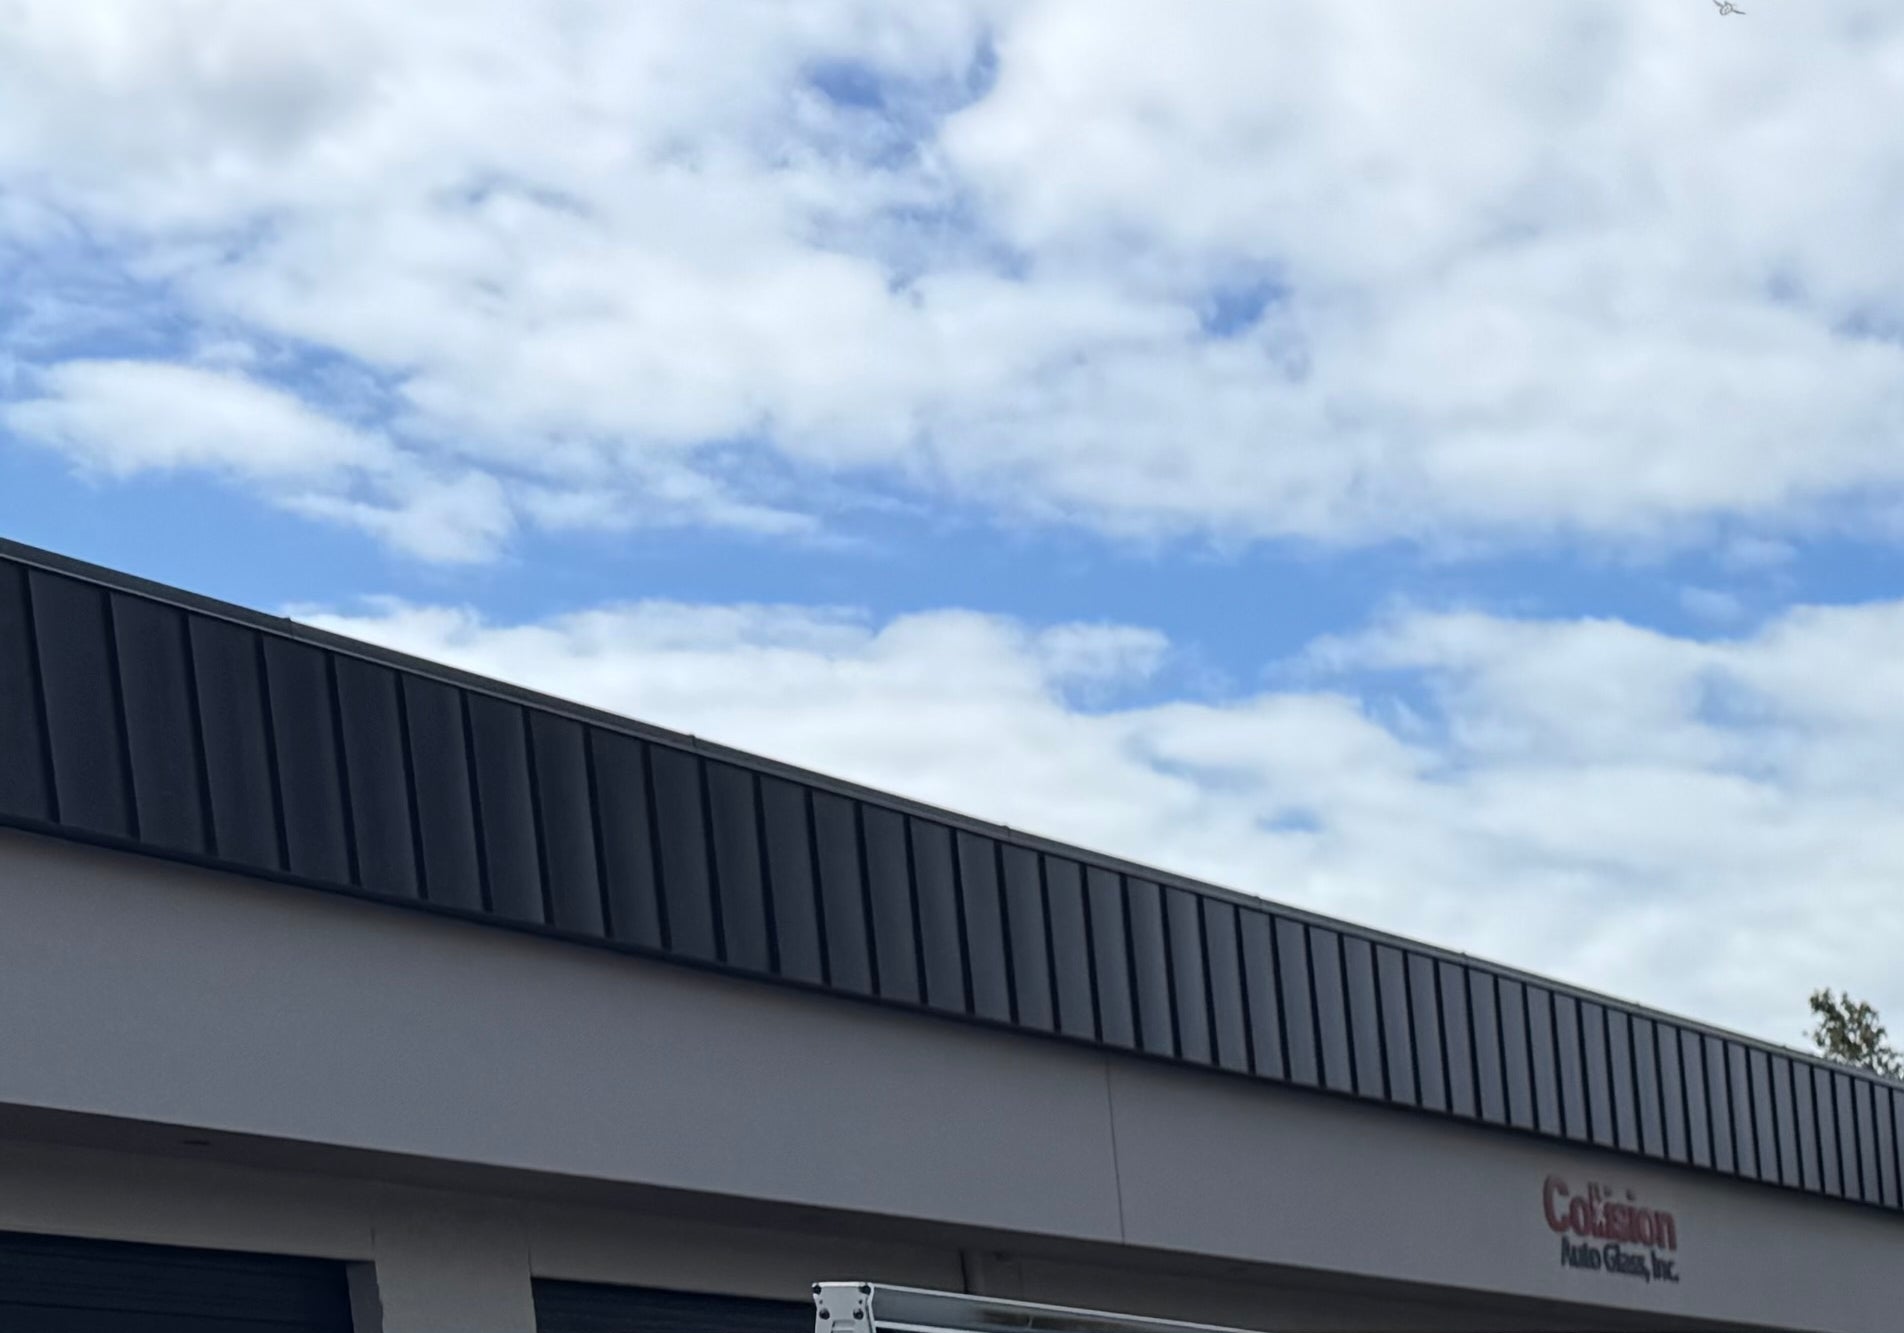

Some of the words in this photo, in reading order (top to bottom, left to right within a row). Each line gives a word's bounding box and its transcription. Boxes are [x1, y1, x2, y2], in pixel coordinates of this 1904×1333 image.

[1543, 1175, 1677, 1252] Collision
[1561, 1235, 1601, 1271] Auto
[1651, 1248, 1680, 1283] Inc.
